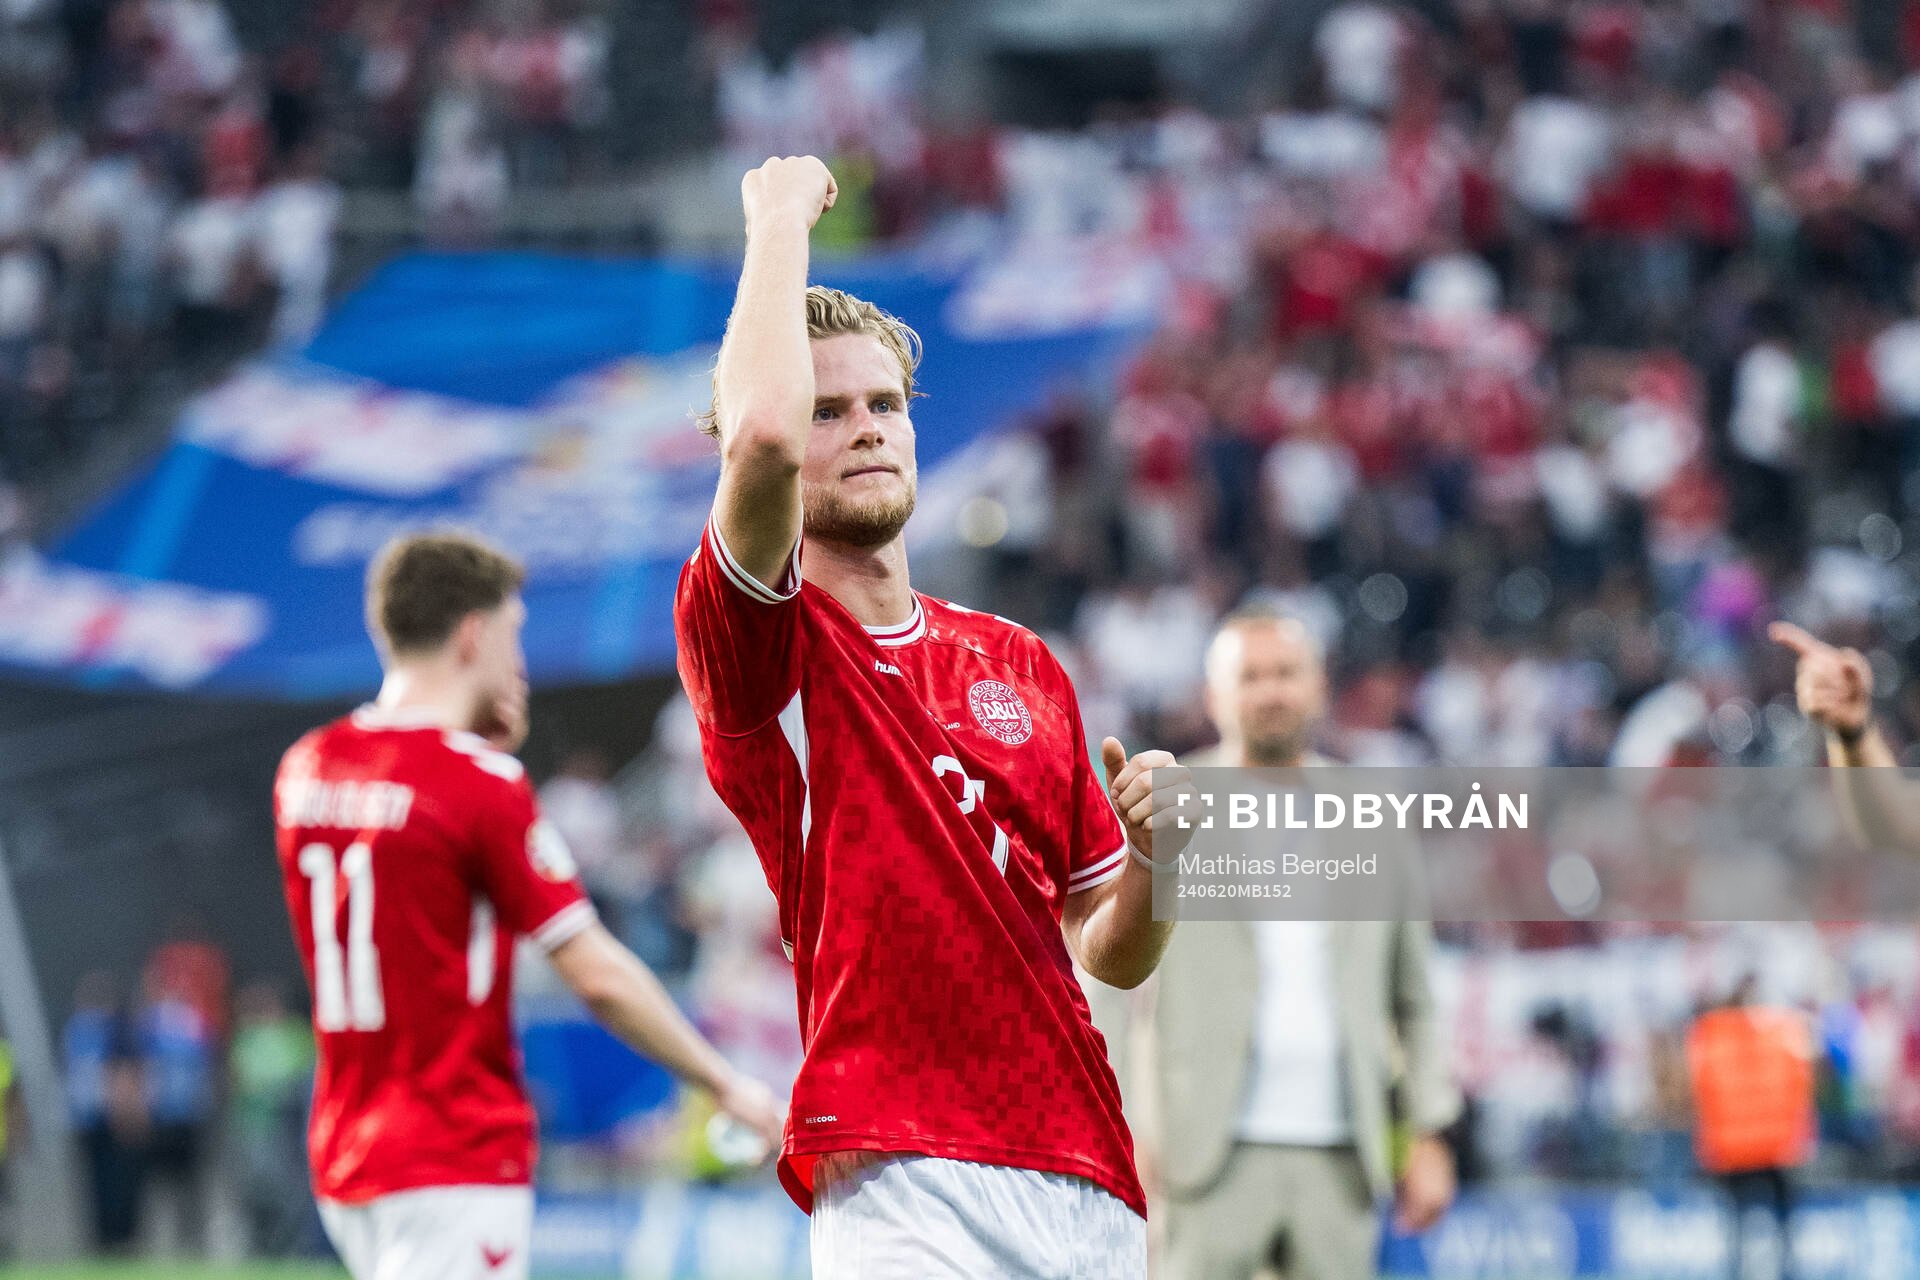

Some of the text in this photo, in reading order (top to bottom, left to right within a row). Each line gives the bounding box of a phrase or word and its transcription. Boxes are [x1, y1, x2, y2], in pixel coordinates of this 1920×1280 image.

[980, 700, 1020, 720] DBU
[1000, 732, 1024, 743] 1889
[298, 842, 386, 1033] 11
